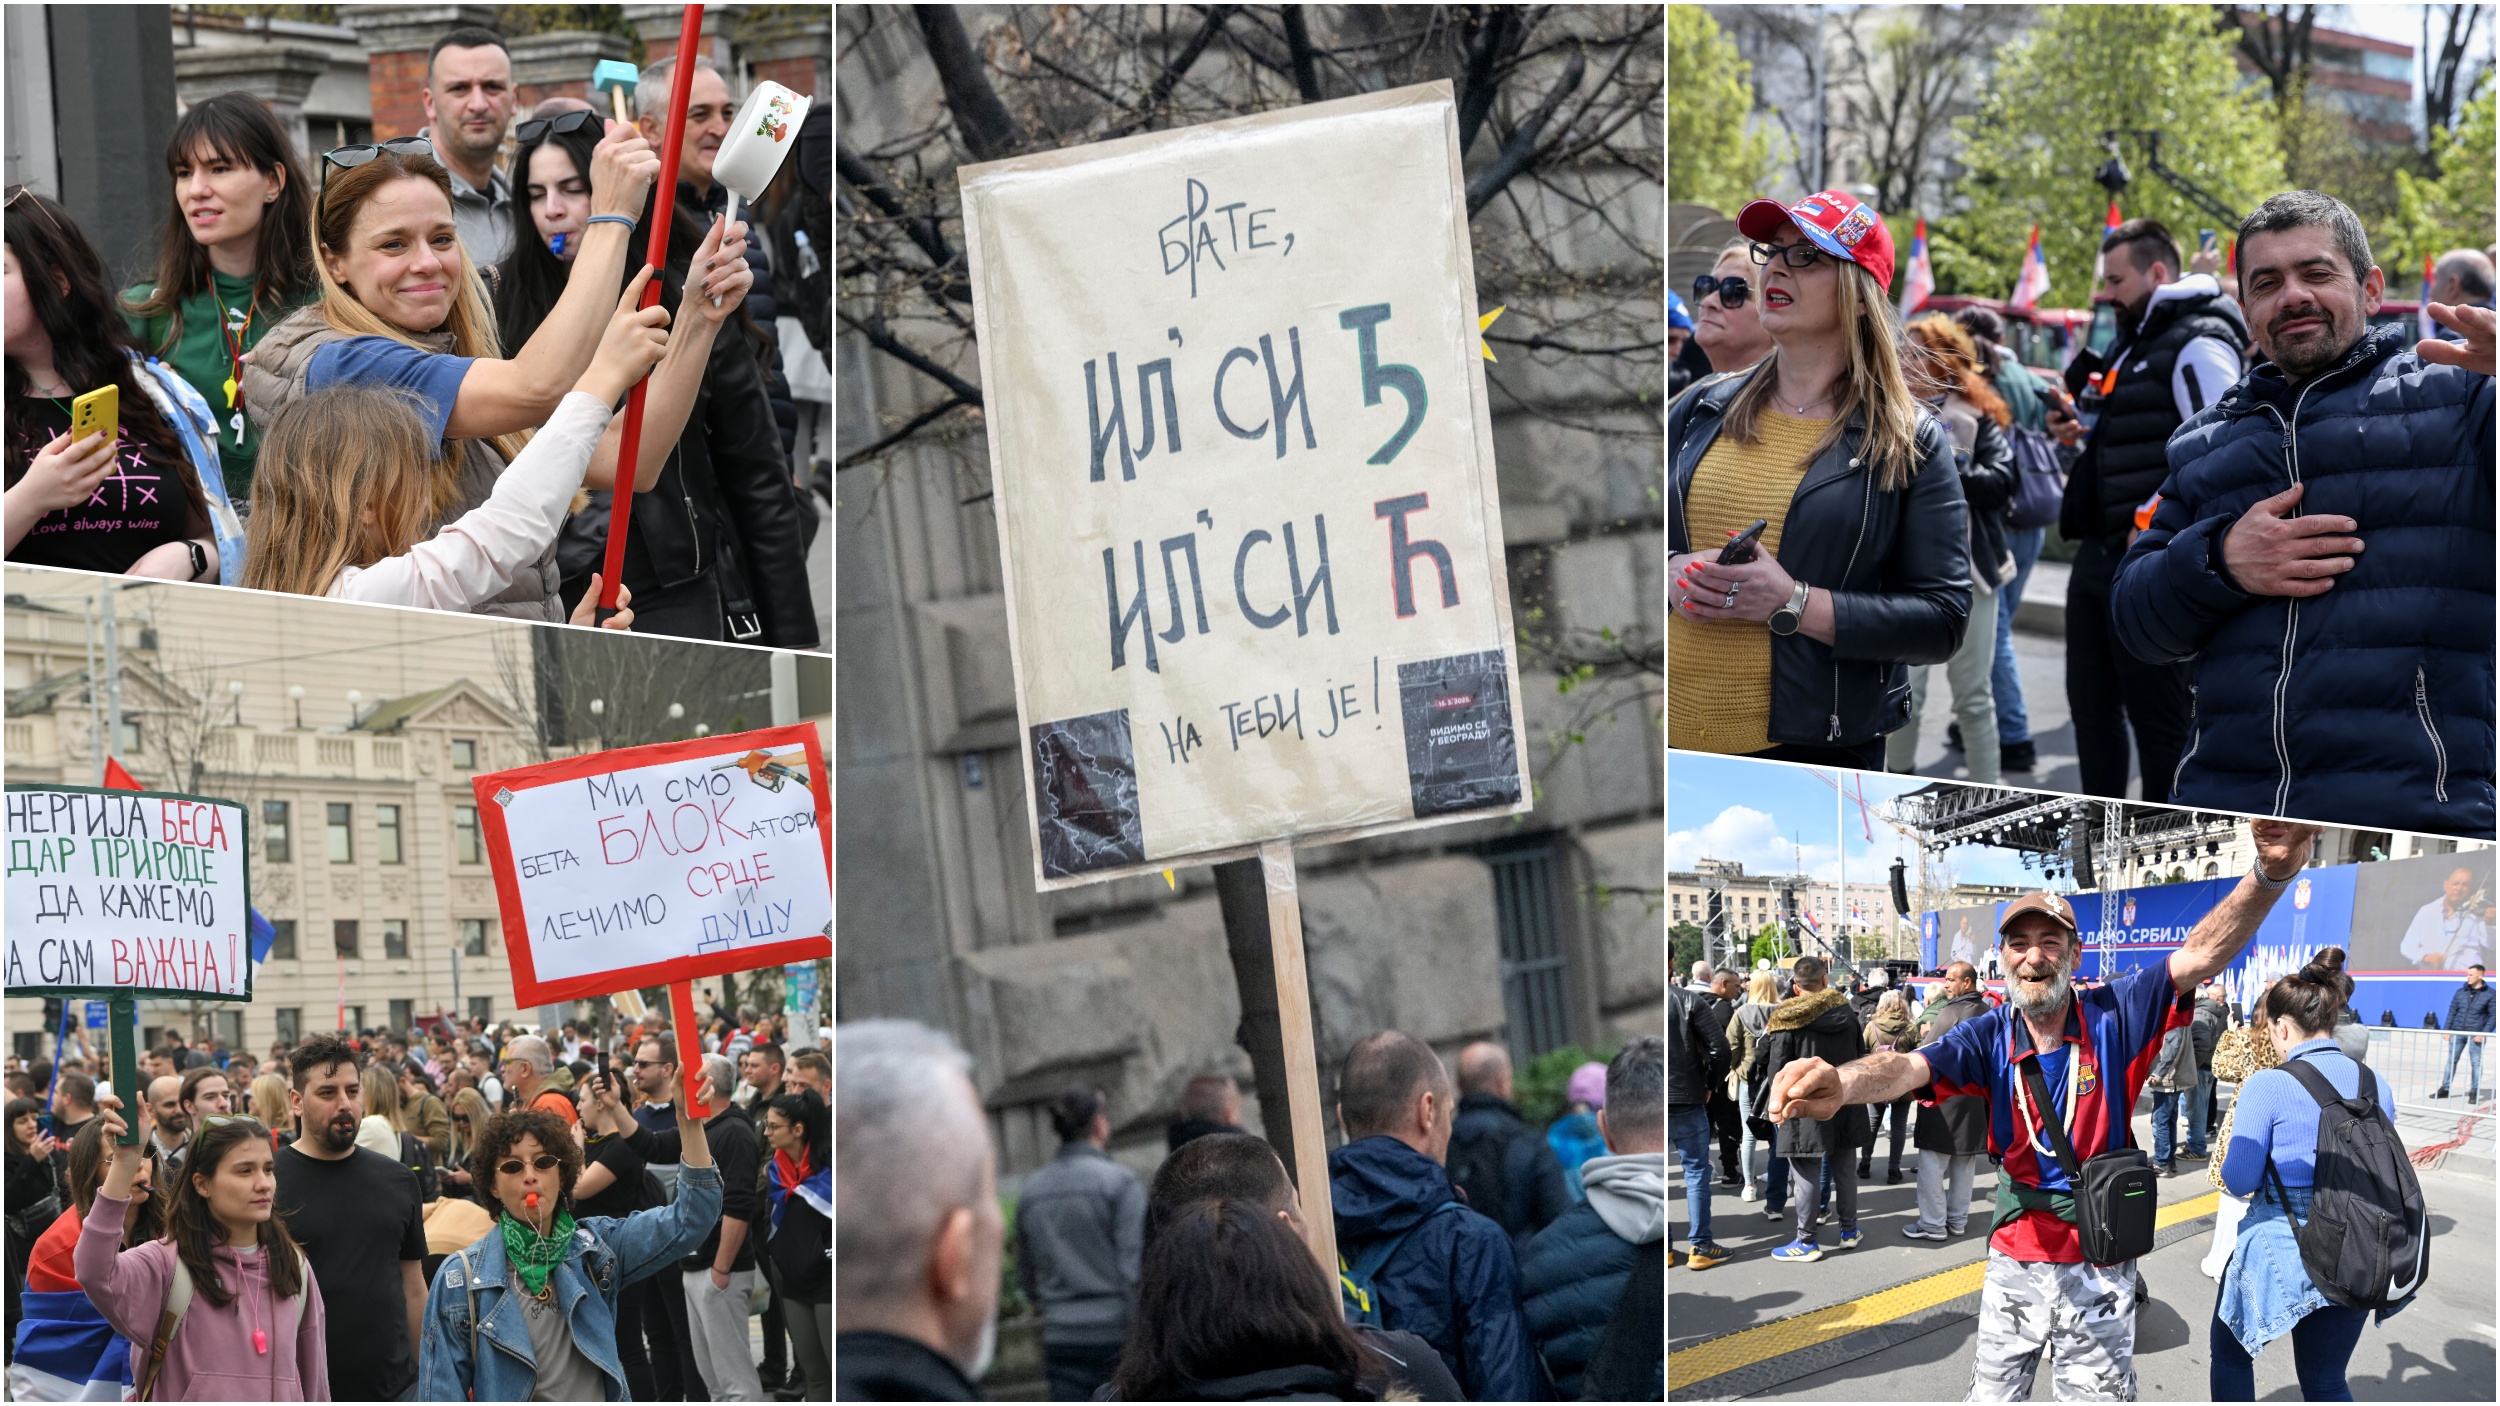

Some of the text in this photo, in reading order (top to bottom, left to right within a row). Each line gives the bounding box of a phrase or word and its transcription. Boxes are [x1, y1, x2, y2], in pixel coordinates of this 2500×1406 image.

[1158, 177, 1296, 298] БРАТЕ,
[1213, 325, 1318, 460] СИ
[1338, 302, 1428, 466] Ђ
[31, 517, 160, 535] Love always wins
[1233, 513, 1341, 638] СИ
[1373, 491, 1461, 620] Ћ
[1160, 715, 1203, 764] НА
[1219, 687, 1305, 751] ТЕБИ
[1430, 722, 1473, 737] ВИДИМО
[5, 792, 228, 851] НЕРГИЈА БЕСА
[7, 837, 218, 888] ДАР ПРИРОДЕ
[520, 849, 580, 879] БЕТА
[36, 883, 215, 928] ДА КАЖЕМО
[542, 852, 776, 943] ЛЕЧИМО СРЦЕ
[697, 898, 793, 956] ДУШУ
[2129, 926, 2194, 943] СРБИЈУ
[4, 939, 27, 986] А
[38, 938, 95, 986] САМ
